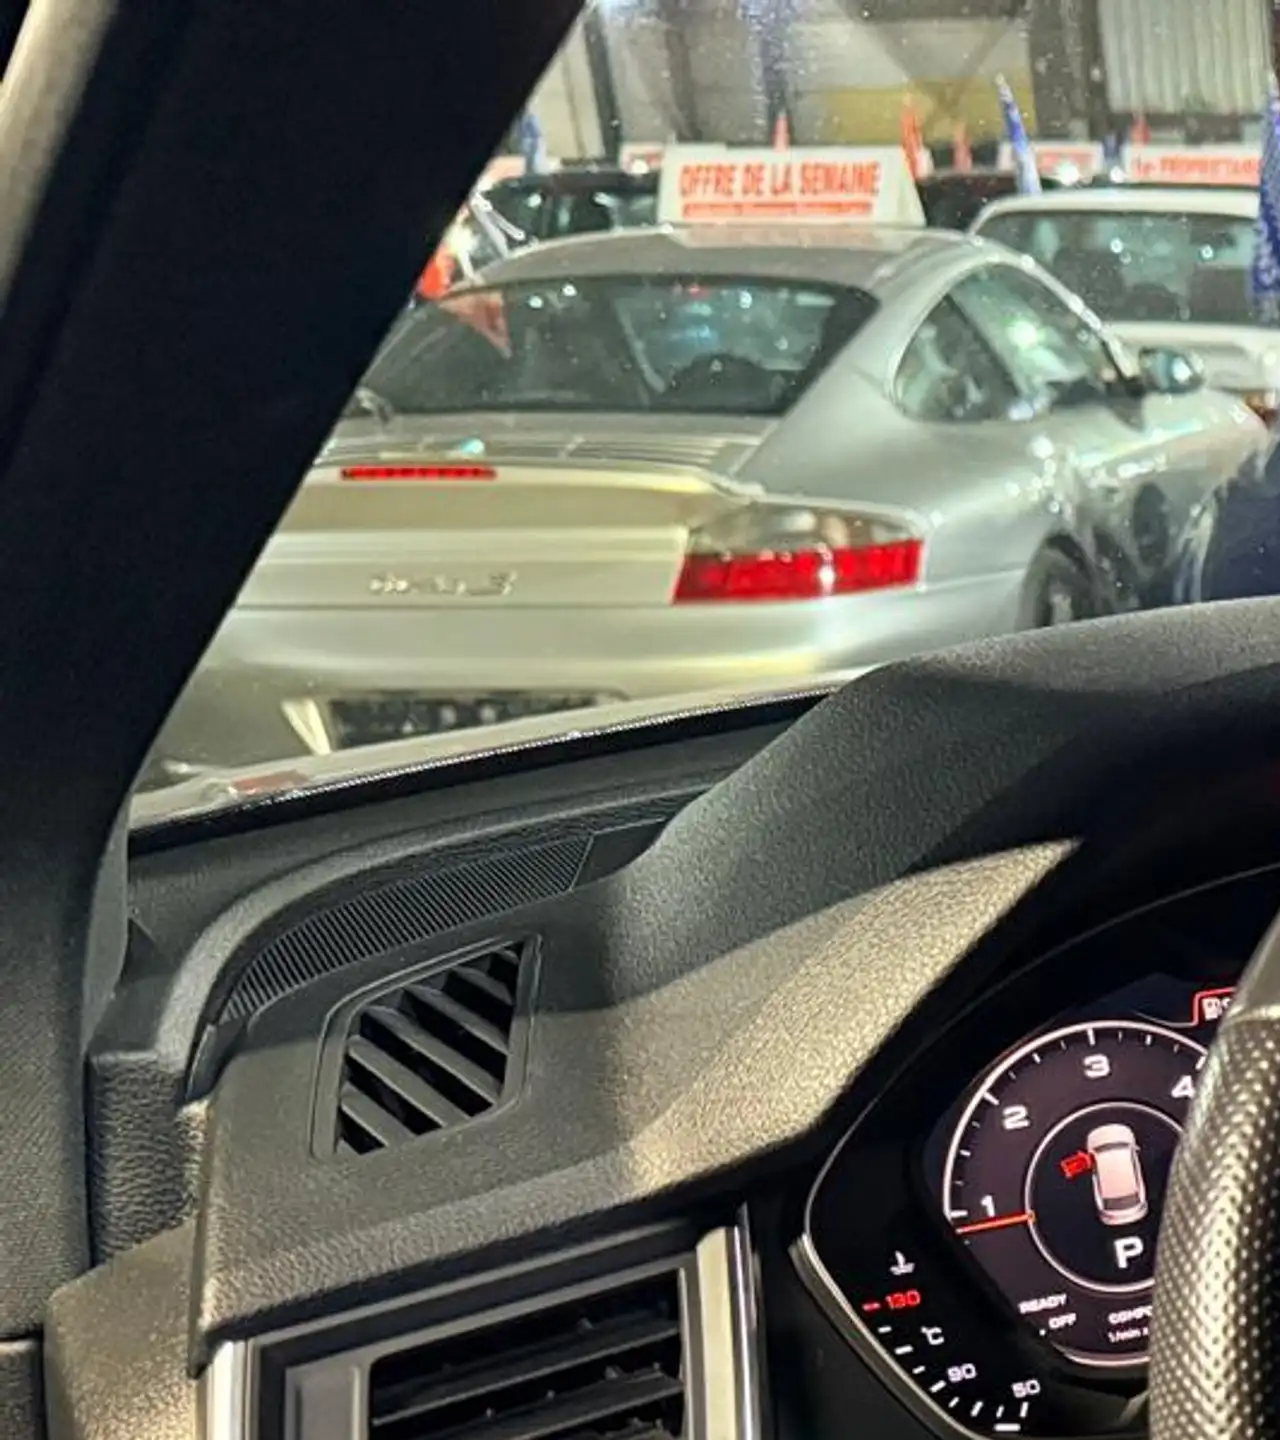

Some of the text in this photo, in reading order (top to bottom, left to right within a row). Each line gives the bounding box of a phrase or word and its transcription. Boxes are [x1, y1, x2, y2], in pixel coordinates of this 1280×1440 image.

[680, 161, 880, 196] OFFRE DE LA SEMAINE
[1084, 1055, 1112, 1079] 3
[1171, 1075, 1196, 1099] 4
[1002, 1105, 1029, 1130] 2
[981, 1194, 994, 1217] 1
[1113, 1237, 1146, 1269] P
[948, 1362, 977, 1383] 90
[1013, 1380, 1041, 1398] 50
